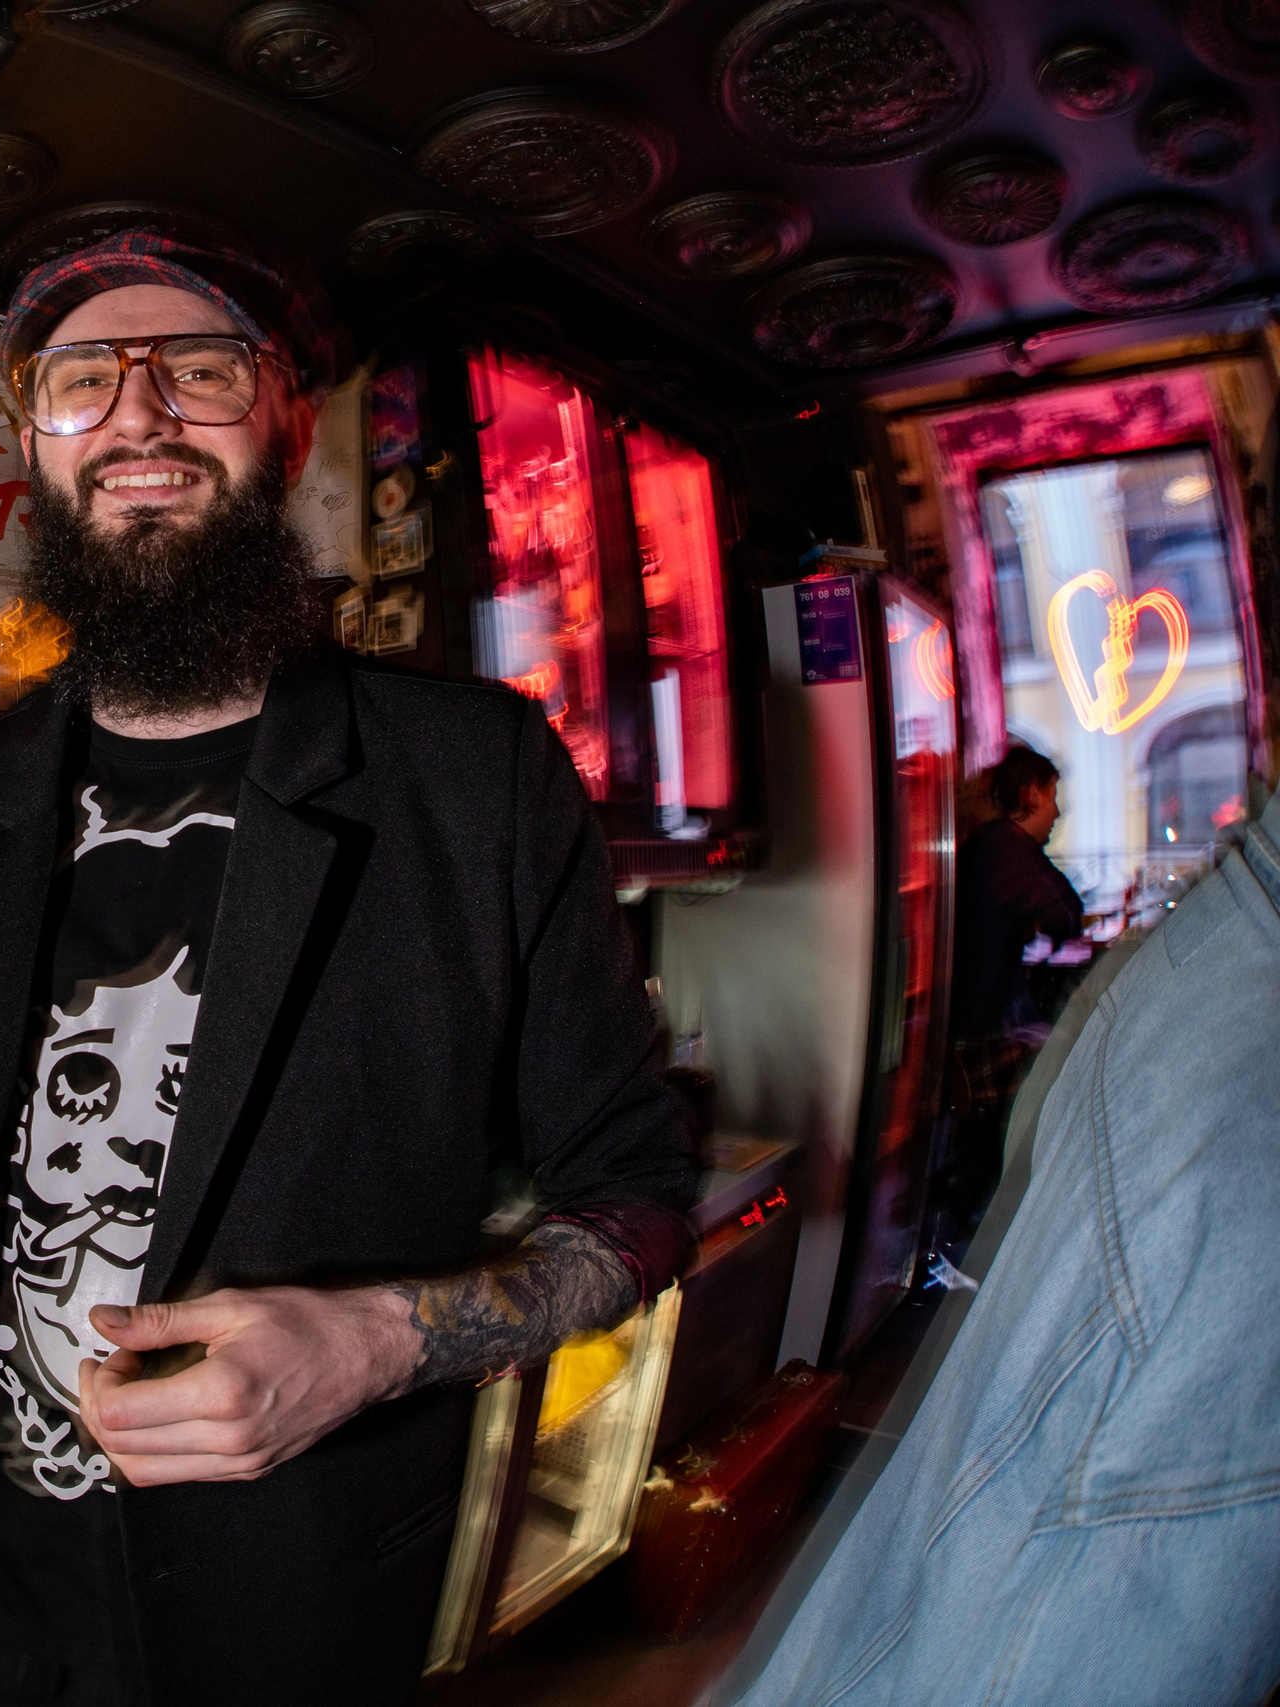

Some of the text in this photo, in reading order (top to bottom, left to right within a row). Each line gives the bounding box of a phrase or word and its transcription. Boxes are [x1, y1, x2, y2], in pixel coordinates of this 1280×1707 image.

[800, 587, 851, 602] 761 08 039
